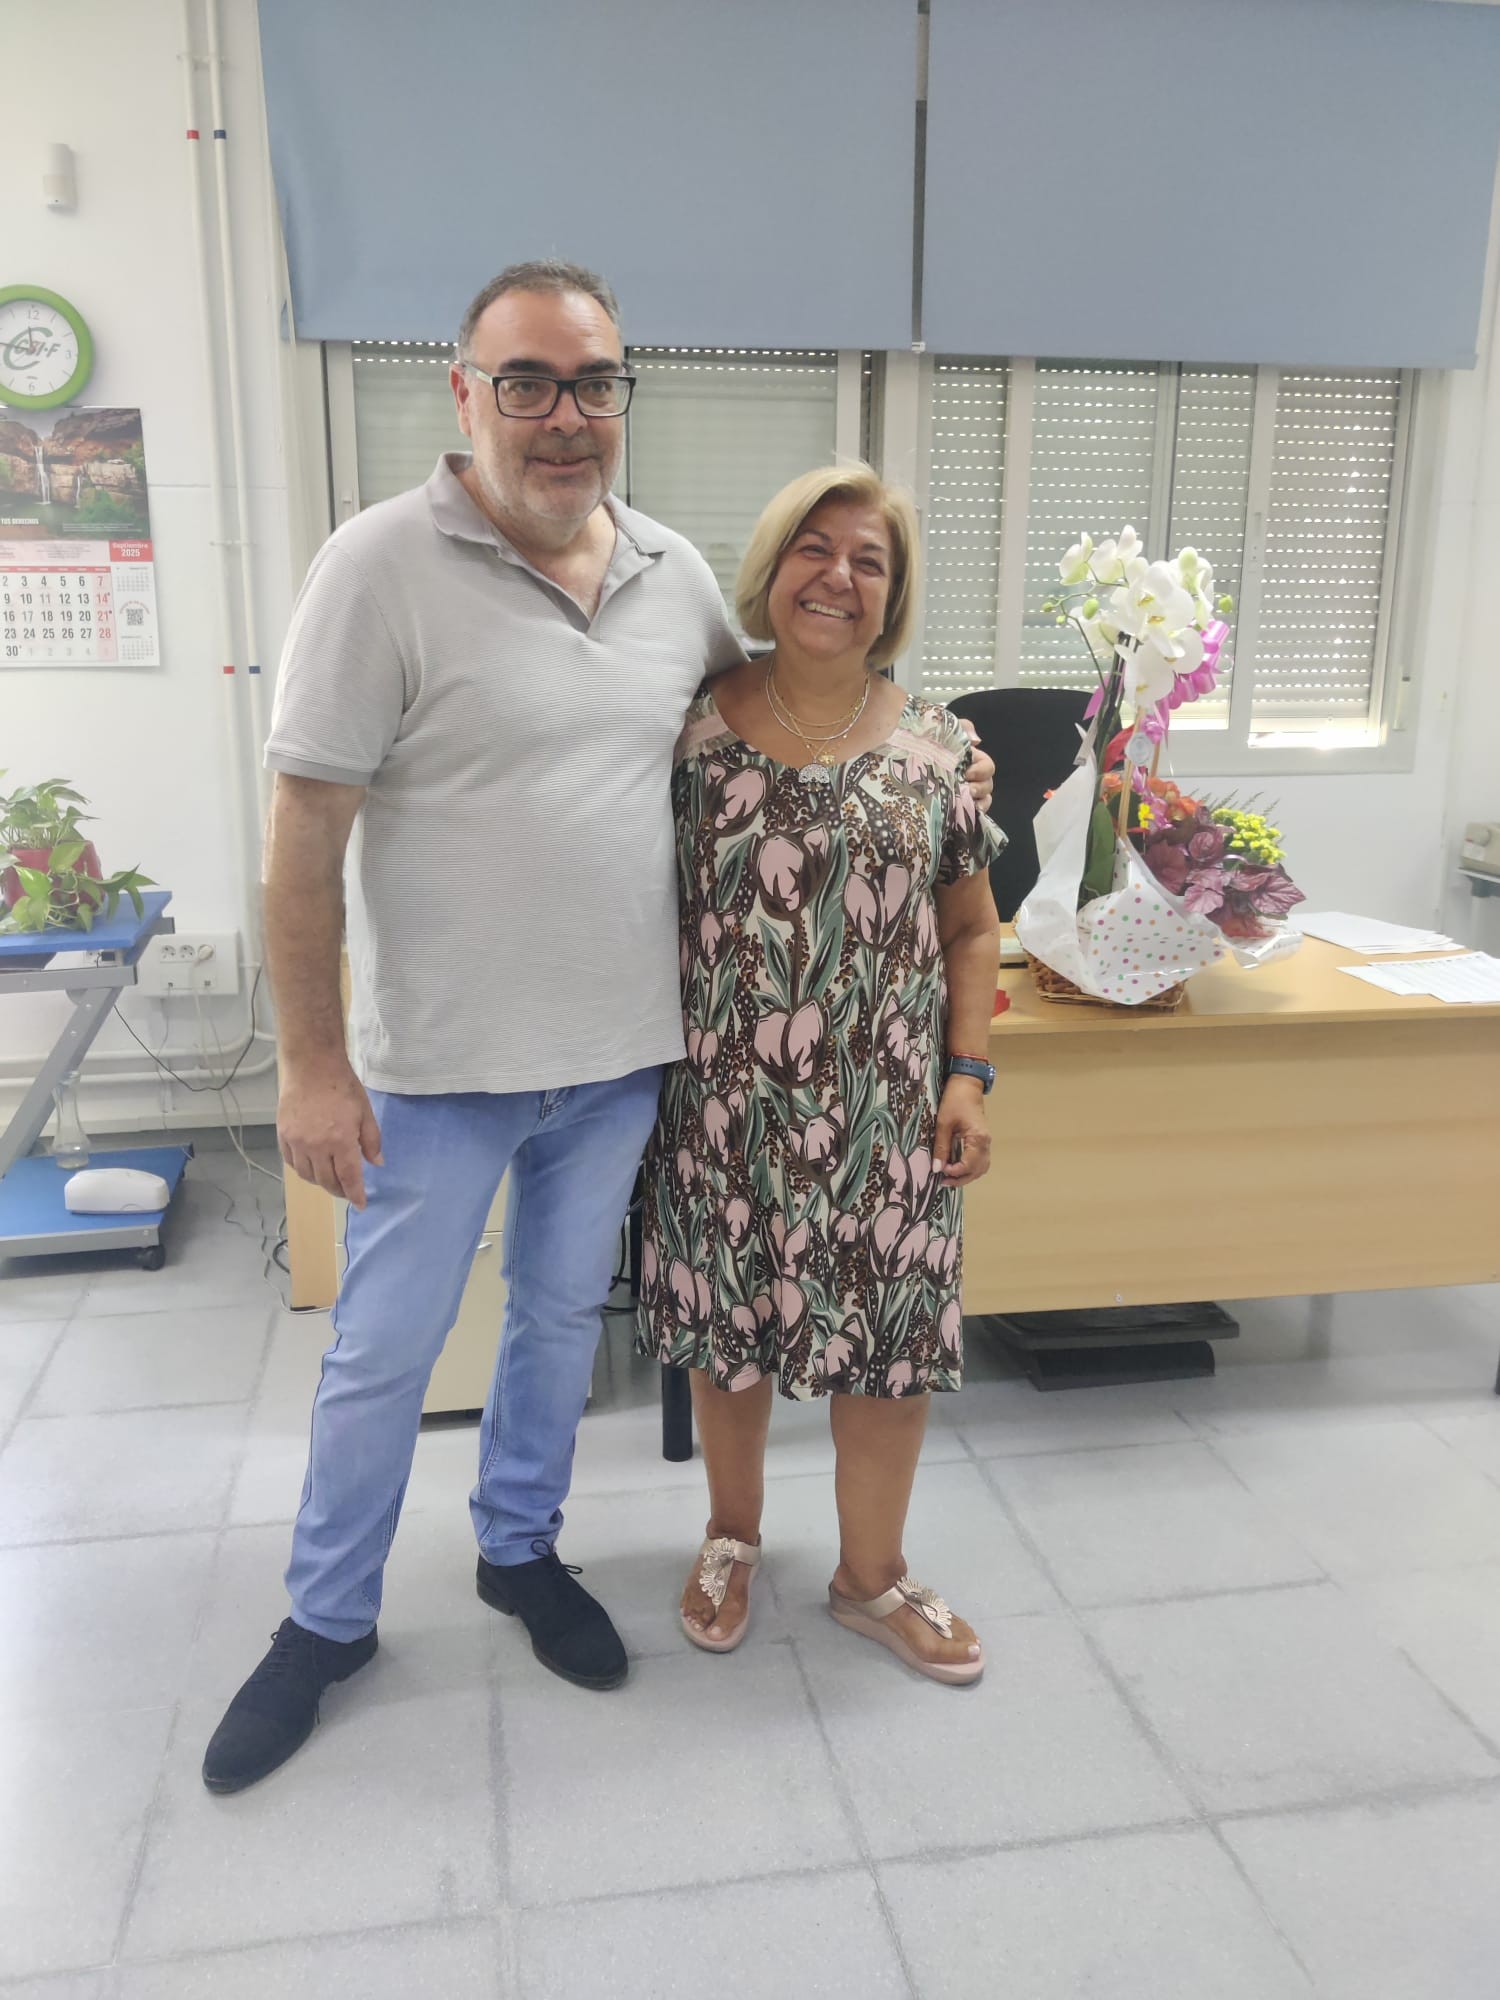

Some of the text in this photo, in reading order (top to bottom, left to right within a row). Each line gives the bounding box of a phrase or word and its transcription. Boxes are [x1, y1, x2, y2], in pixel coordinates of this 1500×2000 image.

[27, 310, 40, 320] 12
[65, 350, 72, 360] 3
[28, 383, 36, 392] 6
[121, 549, 141, 557] 2025
[2, 576, 8, 587] 2
[21, 576, 28, 587] 3
[41, 576, 47, 587] 4
[60, 576, 67, 587] 5
[78, 576, 86, 587] 6
[97, 576, 104, 586] 7
[4, 593, 108, 604] 9 10 11 12 13 14
[3, 611, 109, 622] 16 17 18 19 20 21
[4, 628, 111, 639] 23 24 25 26 27 28
[6, 645, 19, 656] 30
